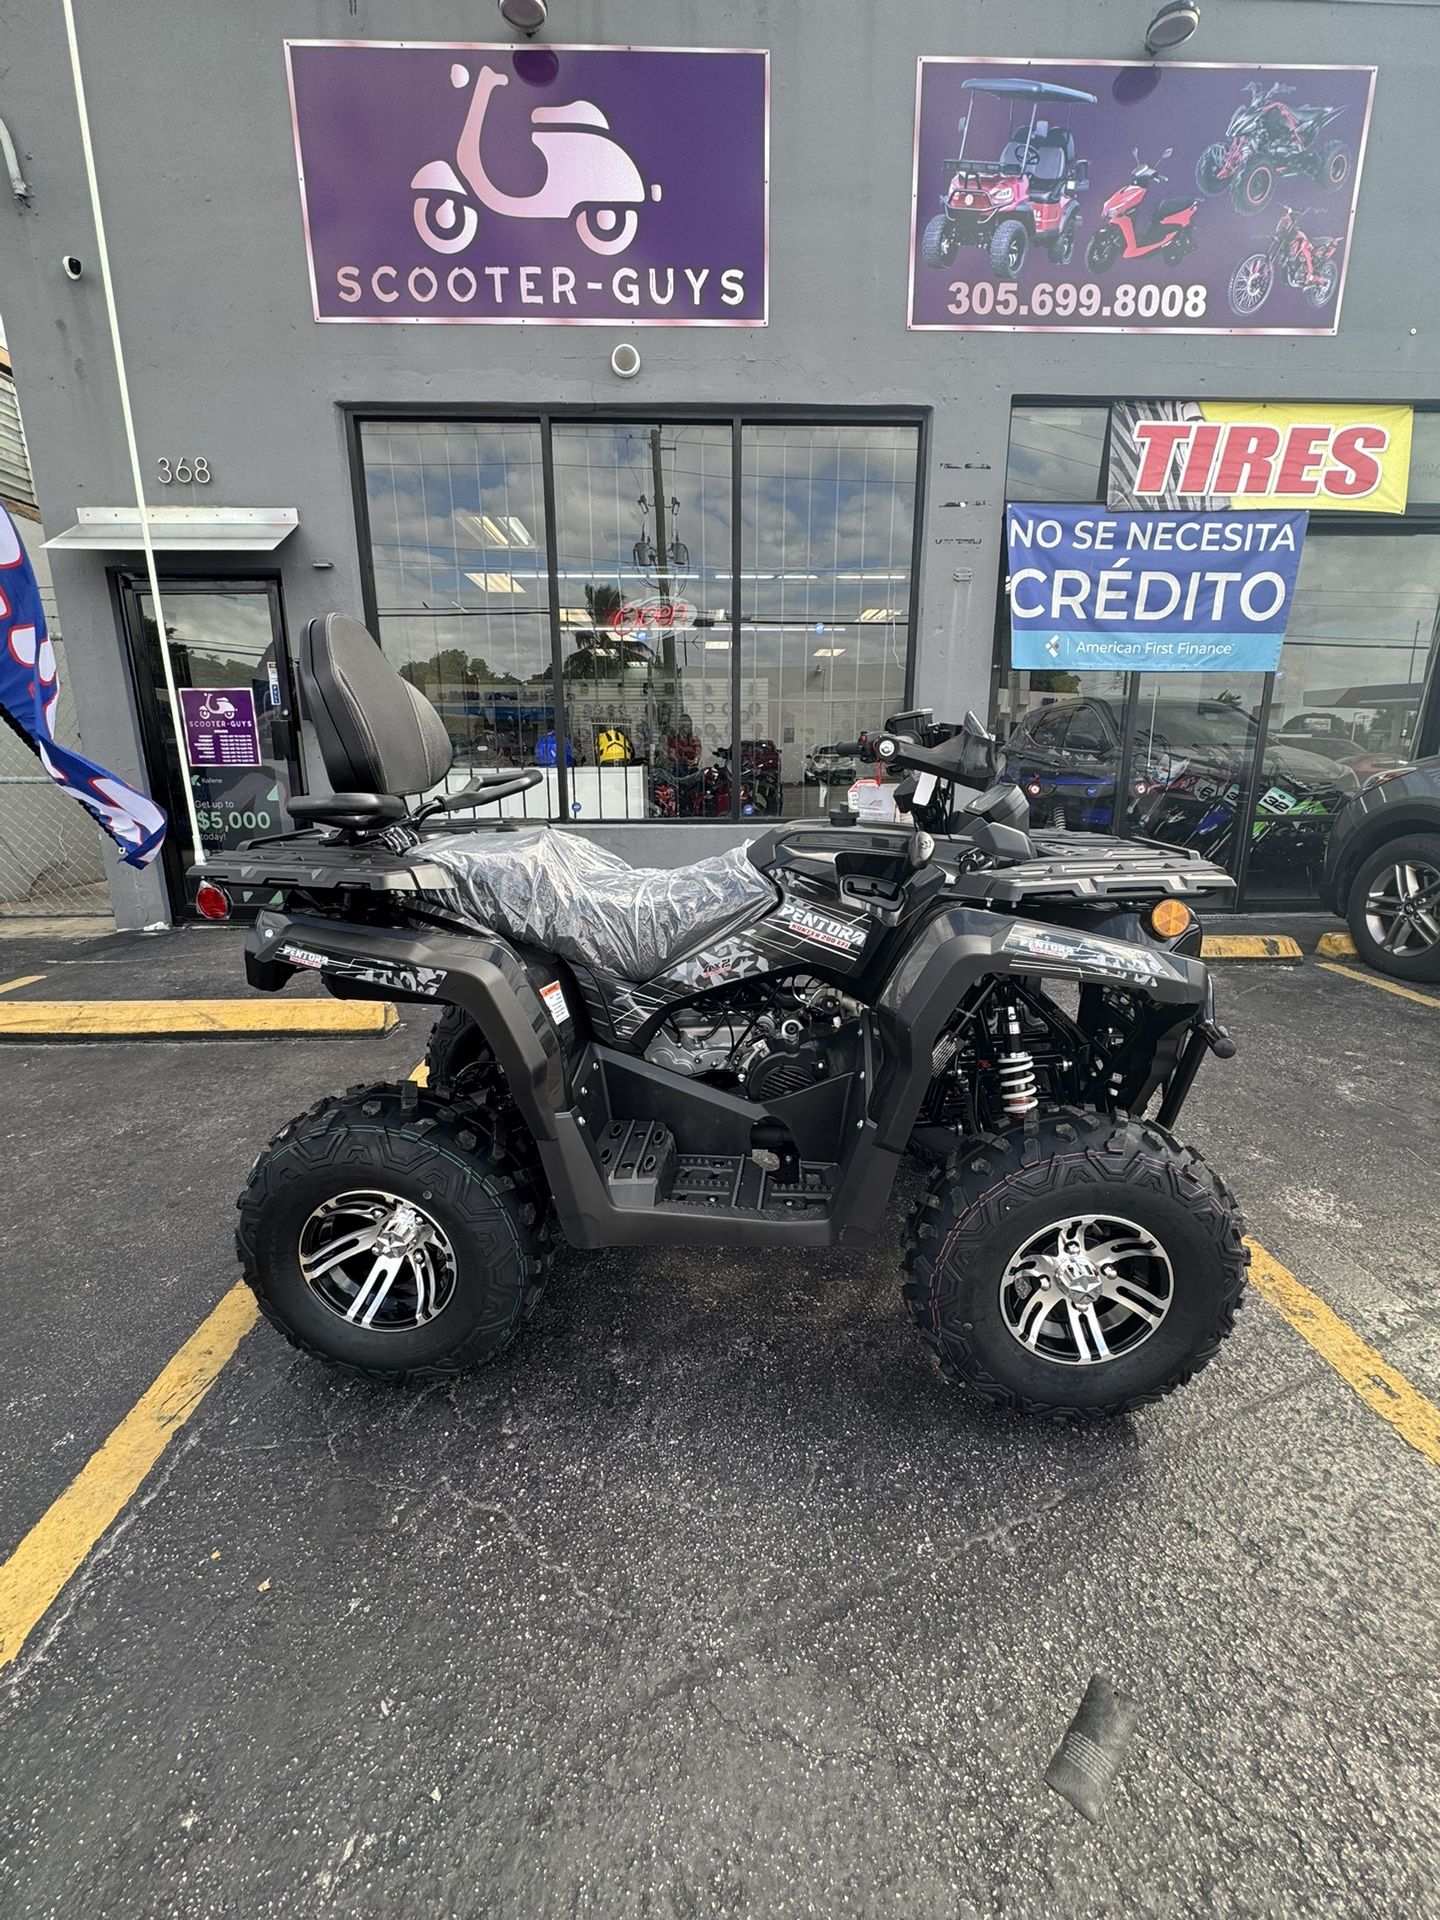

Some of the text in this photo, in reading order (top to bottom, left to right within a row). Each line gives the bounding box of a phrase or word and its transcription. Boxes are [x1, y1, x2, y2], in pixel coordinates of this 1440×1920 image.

[337, 266, 745, 307] SCOOTER-GUYS
[947, 281, 1208, 318] 305.699.8008
[157, 456, 211, 484] 368
[1133, 421, 1390, 498] TIRES
[1010, 519, 1296, 552] NO SE NECESITA
[1010, 557, 1287, 622] CRÉDITO
[613, 602, 689, 637] Open
[1076, 640, 1142, 655] American
[1145, 642, 1174, 655] First
[189, 720, 253, 728] SCOOTER-GUYS
[194, 800, 235, 810] Get up to
[1263, 795, 1290, 812] 32
[197, 810, 271, 833] $5,000
[777, 903, 867, 946] PENTORA
[791, 923, 820, 939] HUNTER
[283, 944, 329, 966] PENTORA
[1019, 939, 1075, 955] PENTORA
